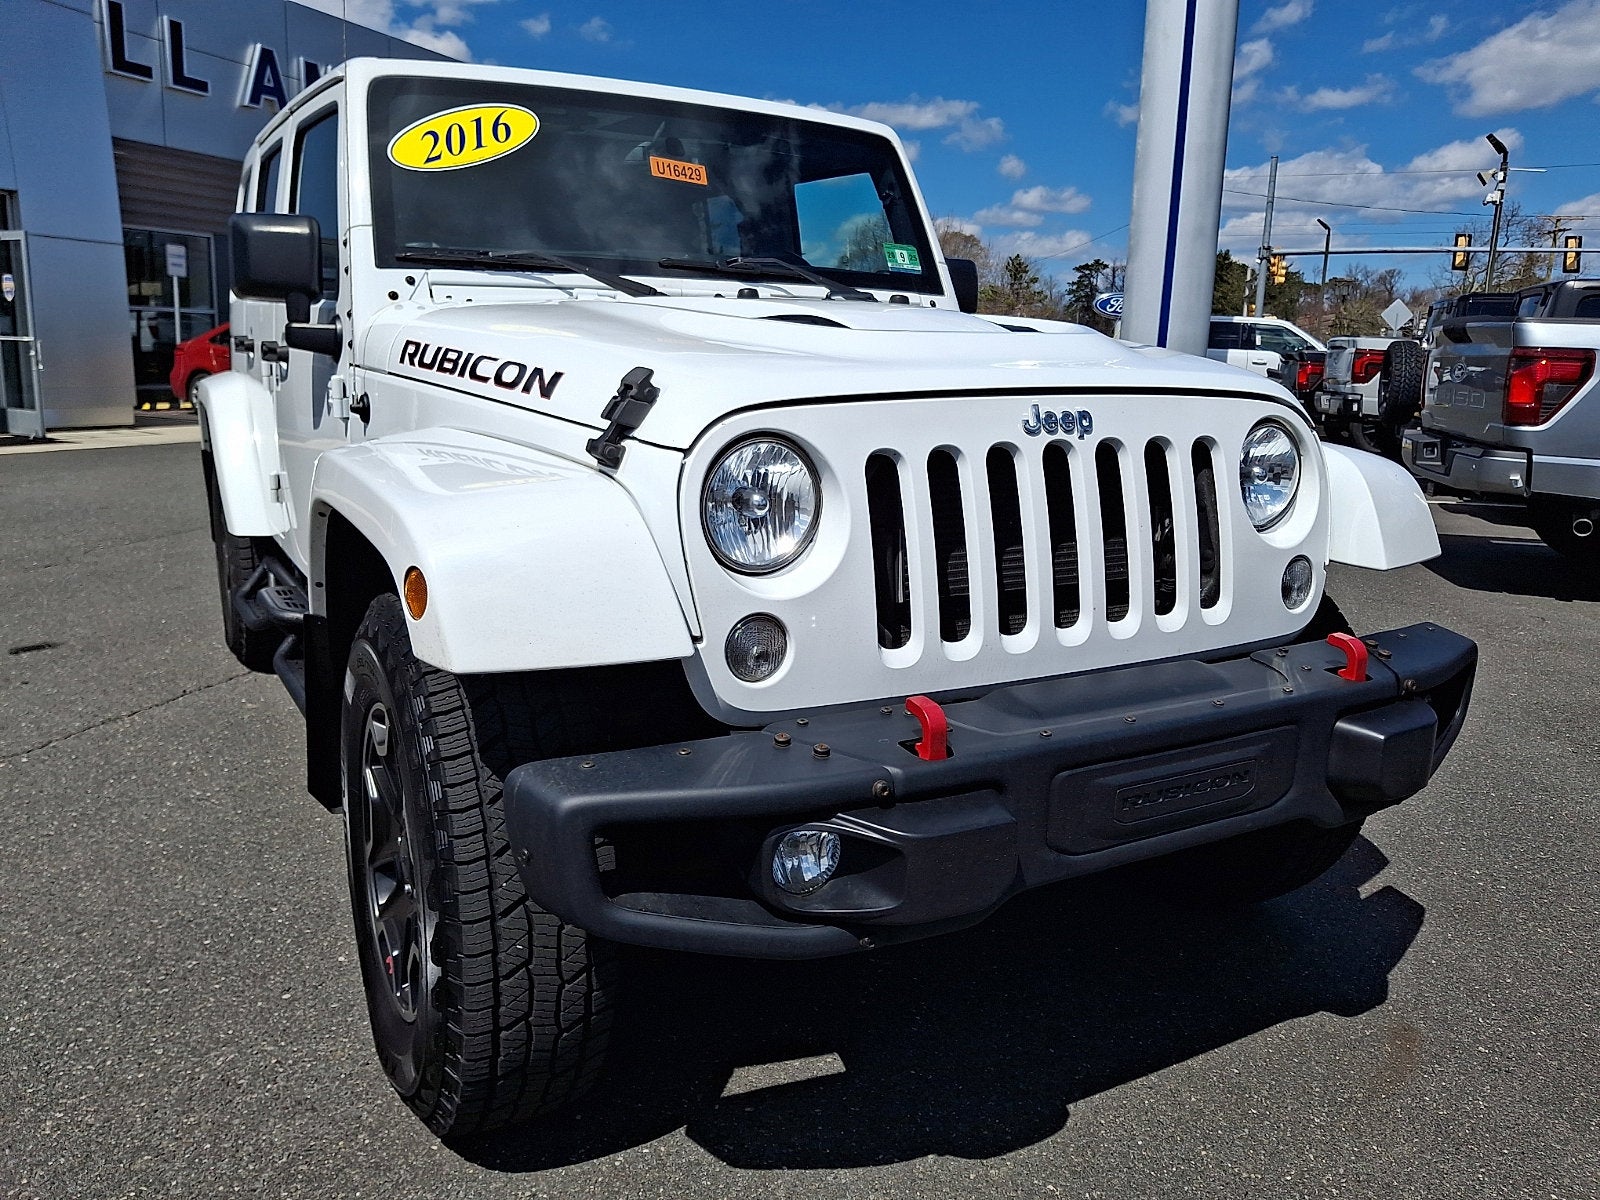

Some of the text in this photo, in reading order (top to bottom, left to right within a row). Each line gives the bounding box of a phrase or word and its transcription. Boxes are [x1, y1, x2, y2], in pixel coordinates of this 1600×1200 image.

[420, 109, 512, 165] 2016
[656, 161, 702, 181] U16429
[899, 252, 906, 263] 9
[399, 339, 565, 400] RUBICON
[1022, 403, 1094, 440] Jeep
[1122, 769, 1252, 812] RUBICON
